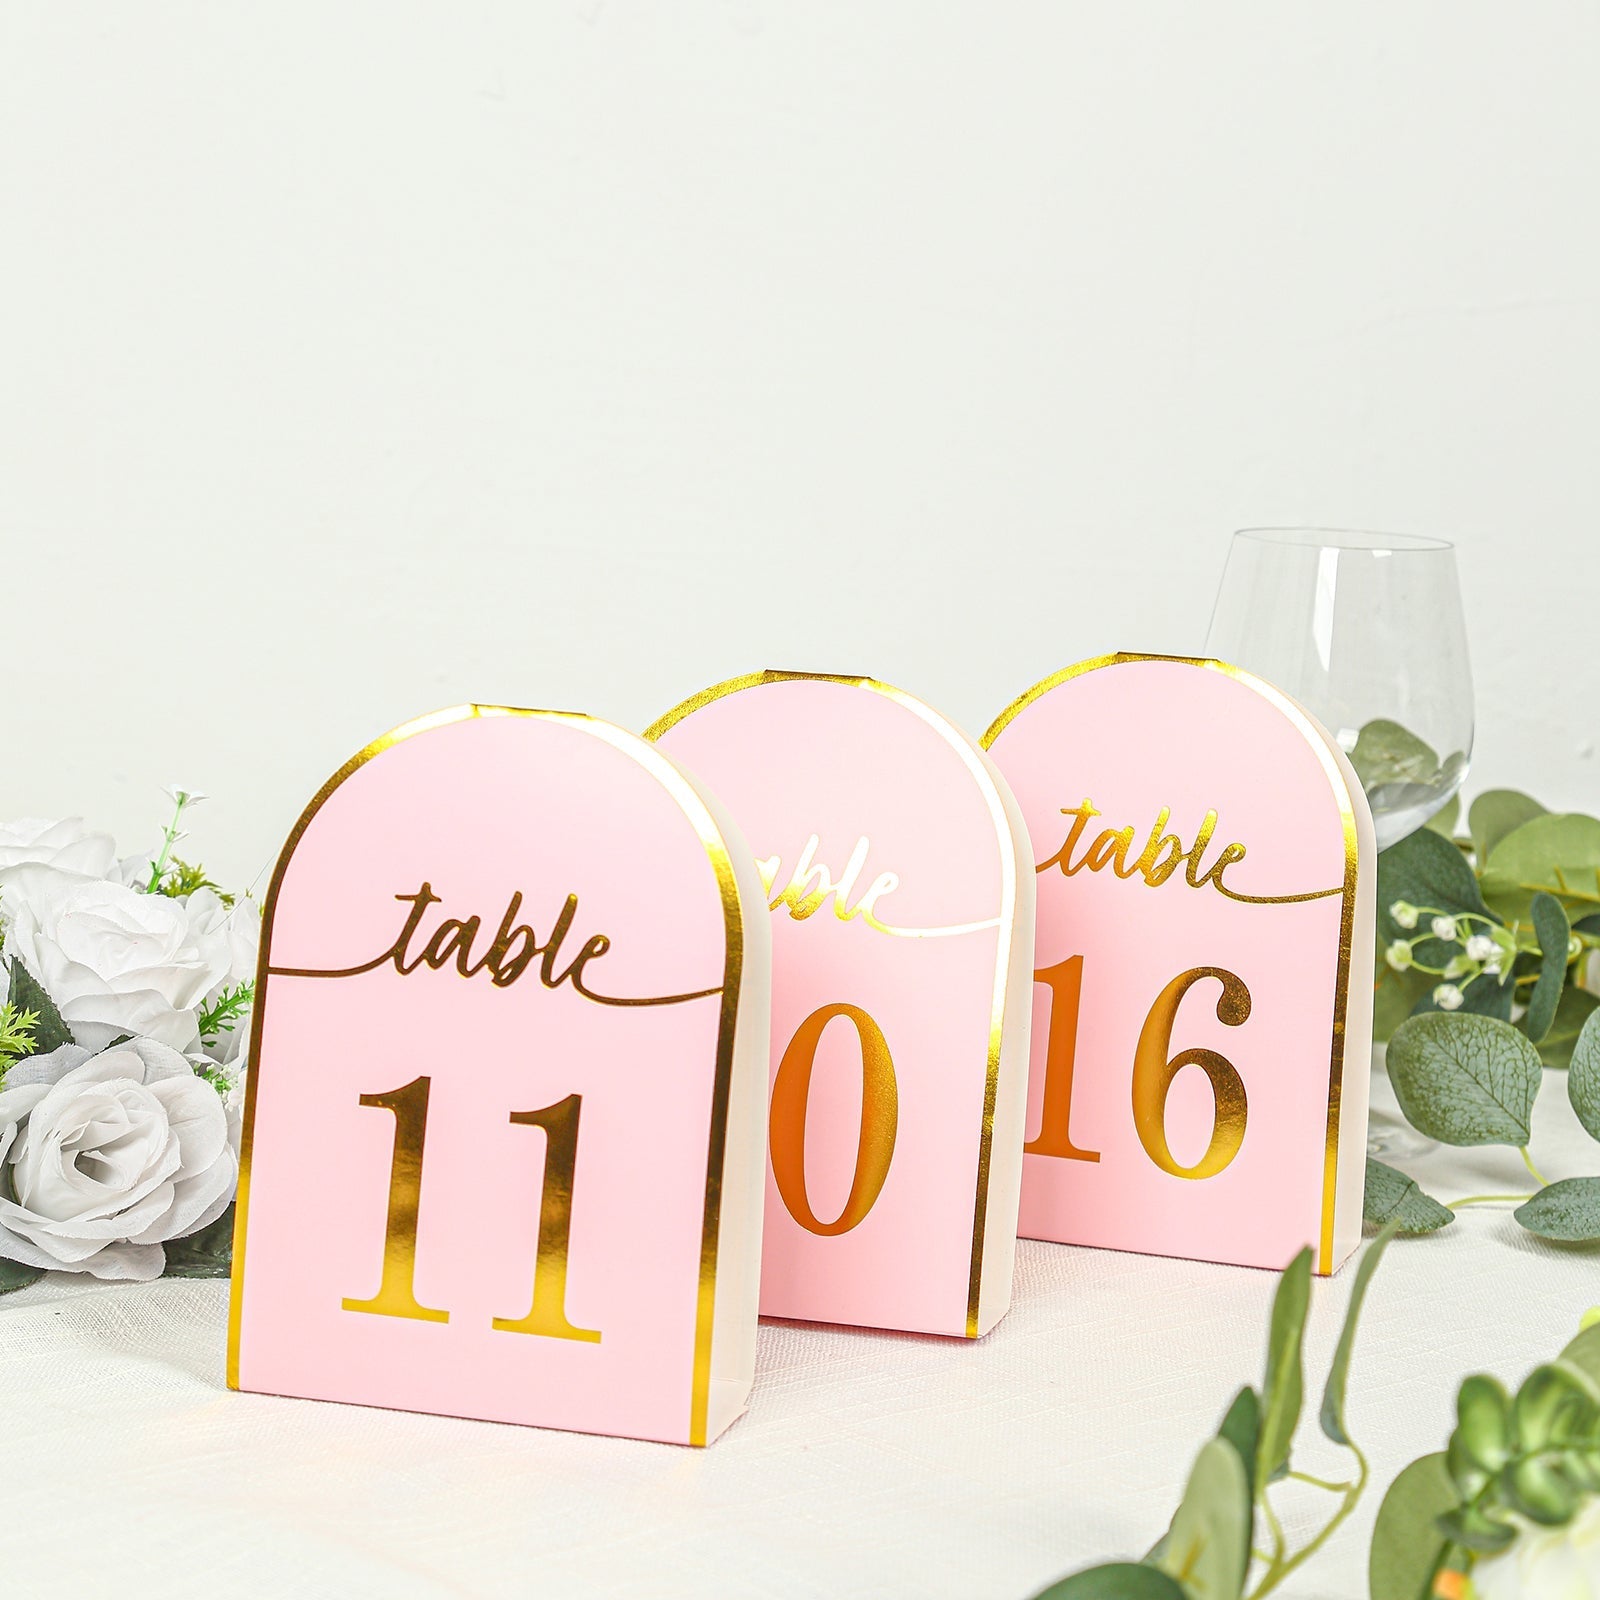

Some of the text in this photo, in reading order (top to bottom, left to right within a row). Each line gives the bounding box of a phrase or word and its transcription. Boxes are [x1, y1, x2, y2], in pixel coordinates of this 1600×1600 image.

[1035, 797, 1300, 904] table
[340, 881, 660, 1006] table
[1023, 953, 1252, 1180] 16
[341, 1075, 603, 1344] 11
